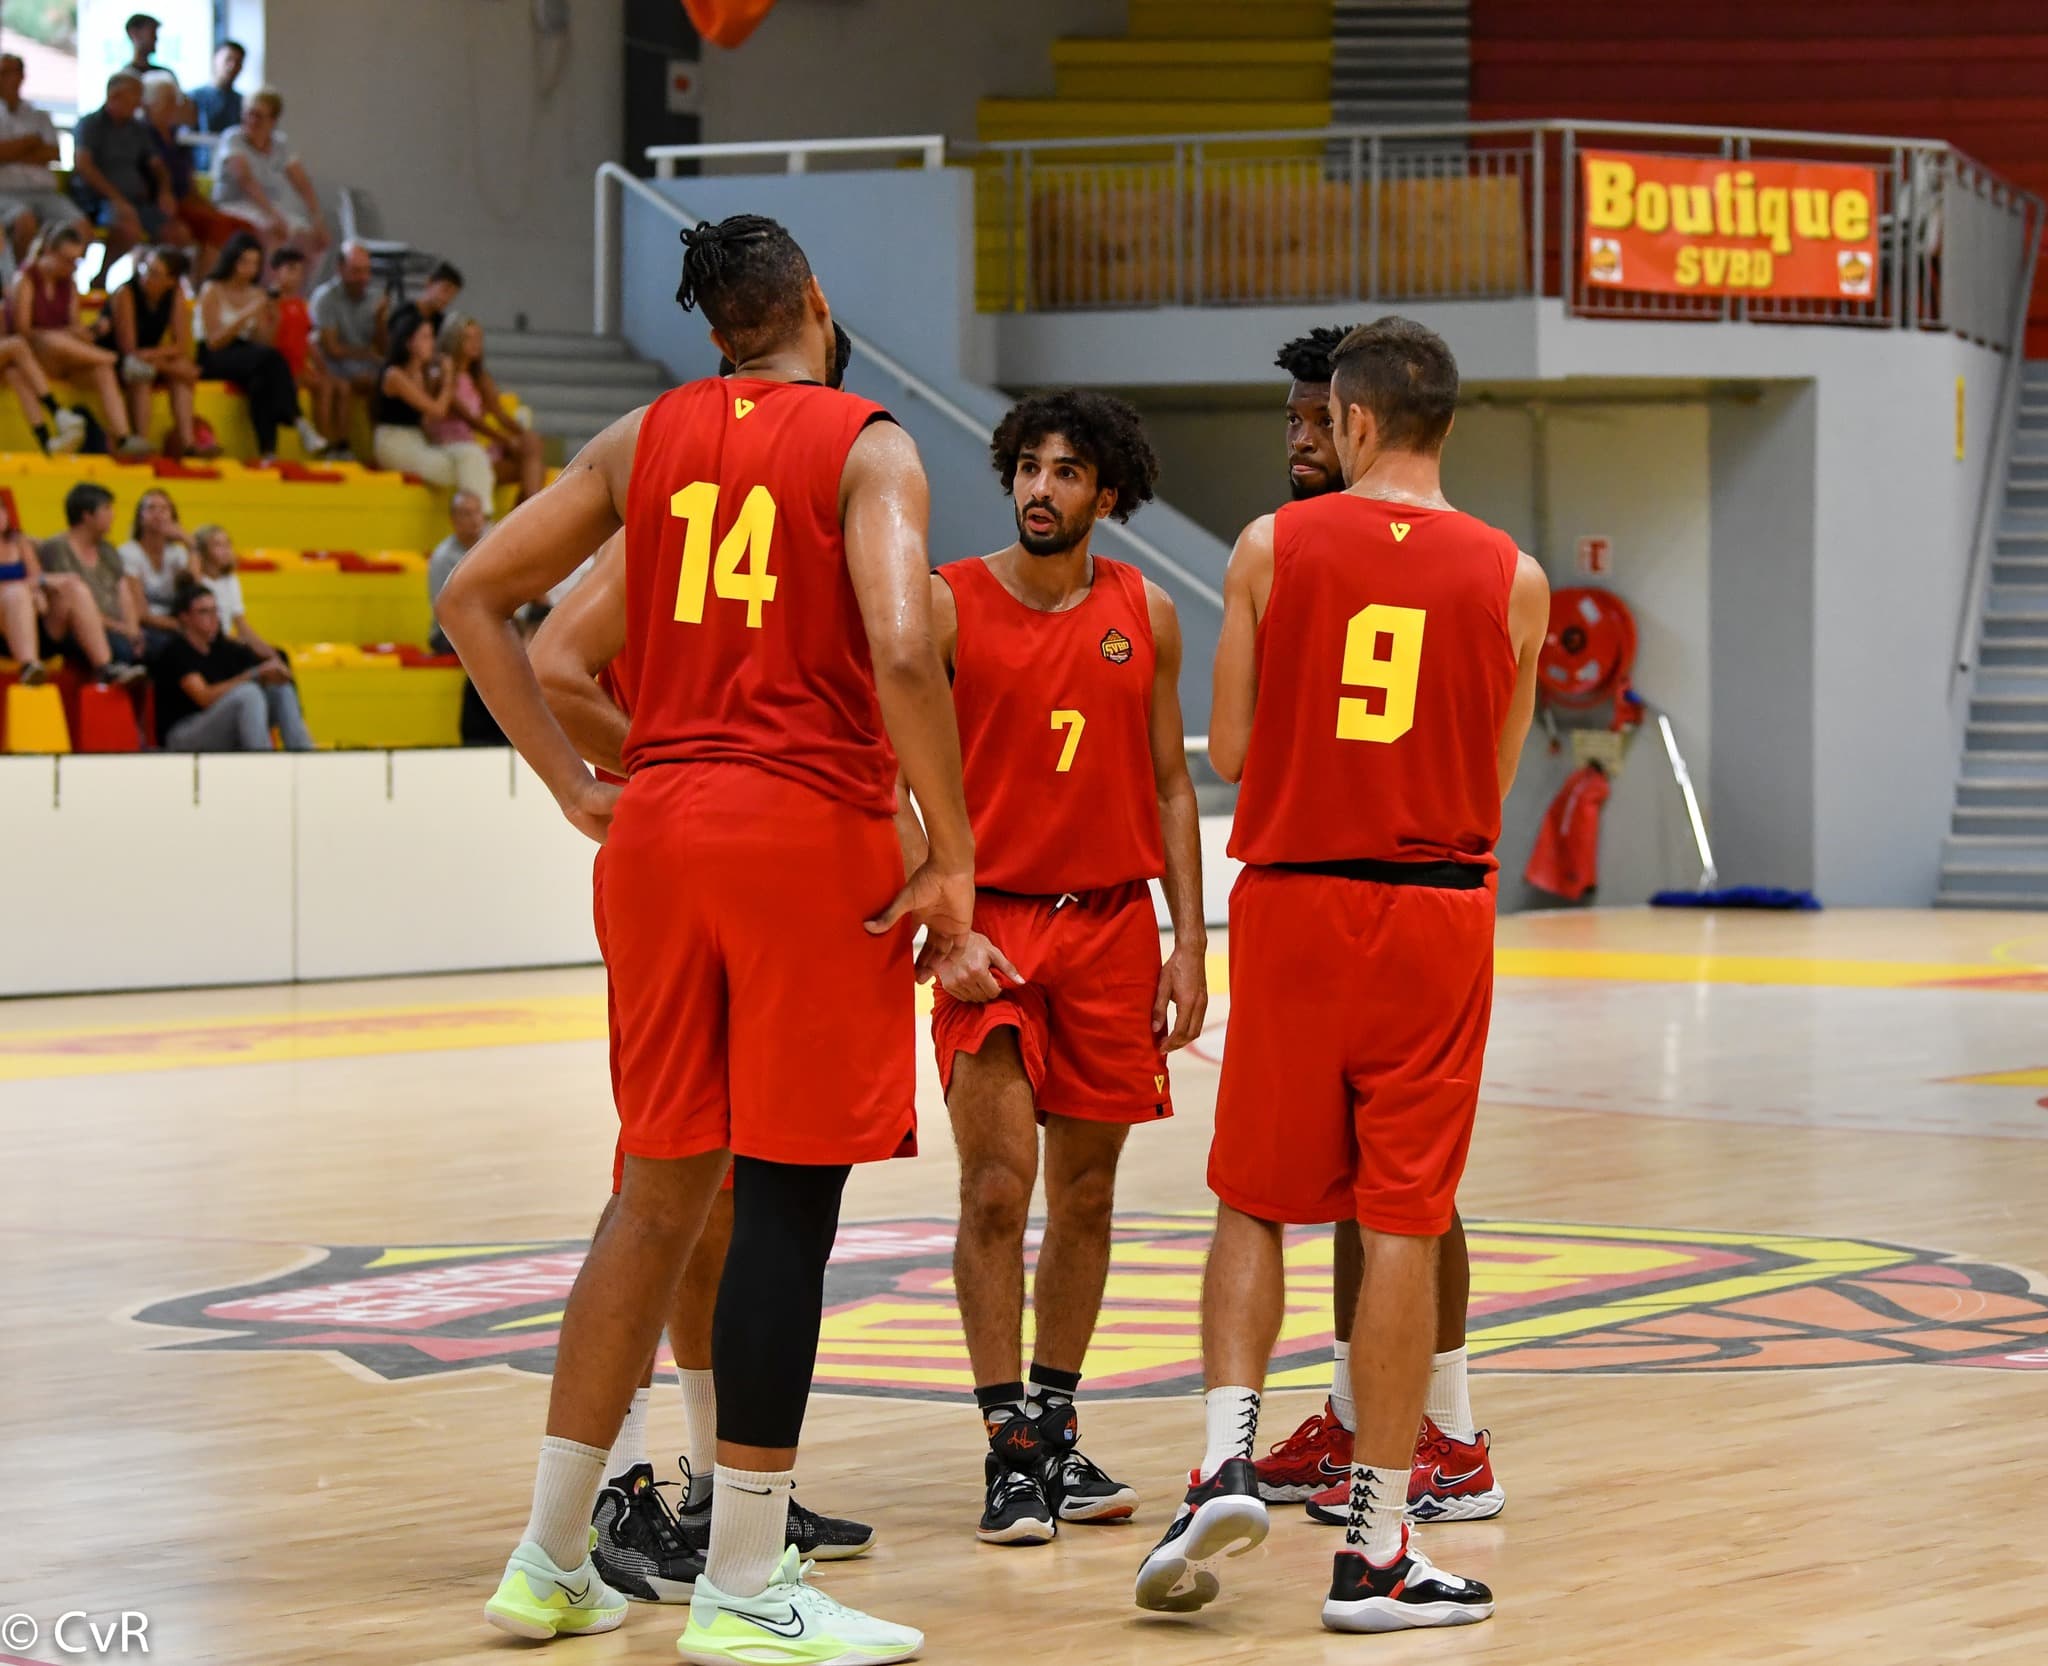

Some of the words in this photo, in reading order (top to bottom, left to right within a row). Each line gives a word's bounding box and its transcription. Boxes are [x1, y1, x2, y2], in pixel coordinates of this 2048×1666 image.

[1587, 160, 1869, 255] Boutique
[1674, 246, 1774, 288] SVBD
[671, 481, 777, 628] 14
[1336, 603, 1426, 743] 9
[1050, 710, 1086, 771] 7
